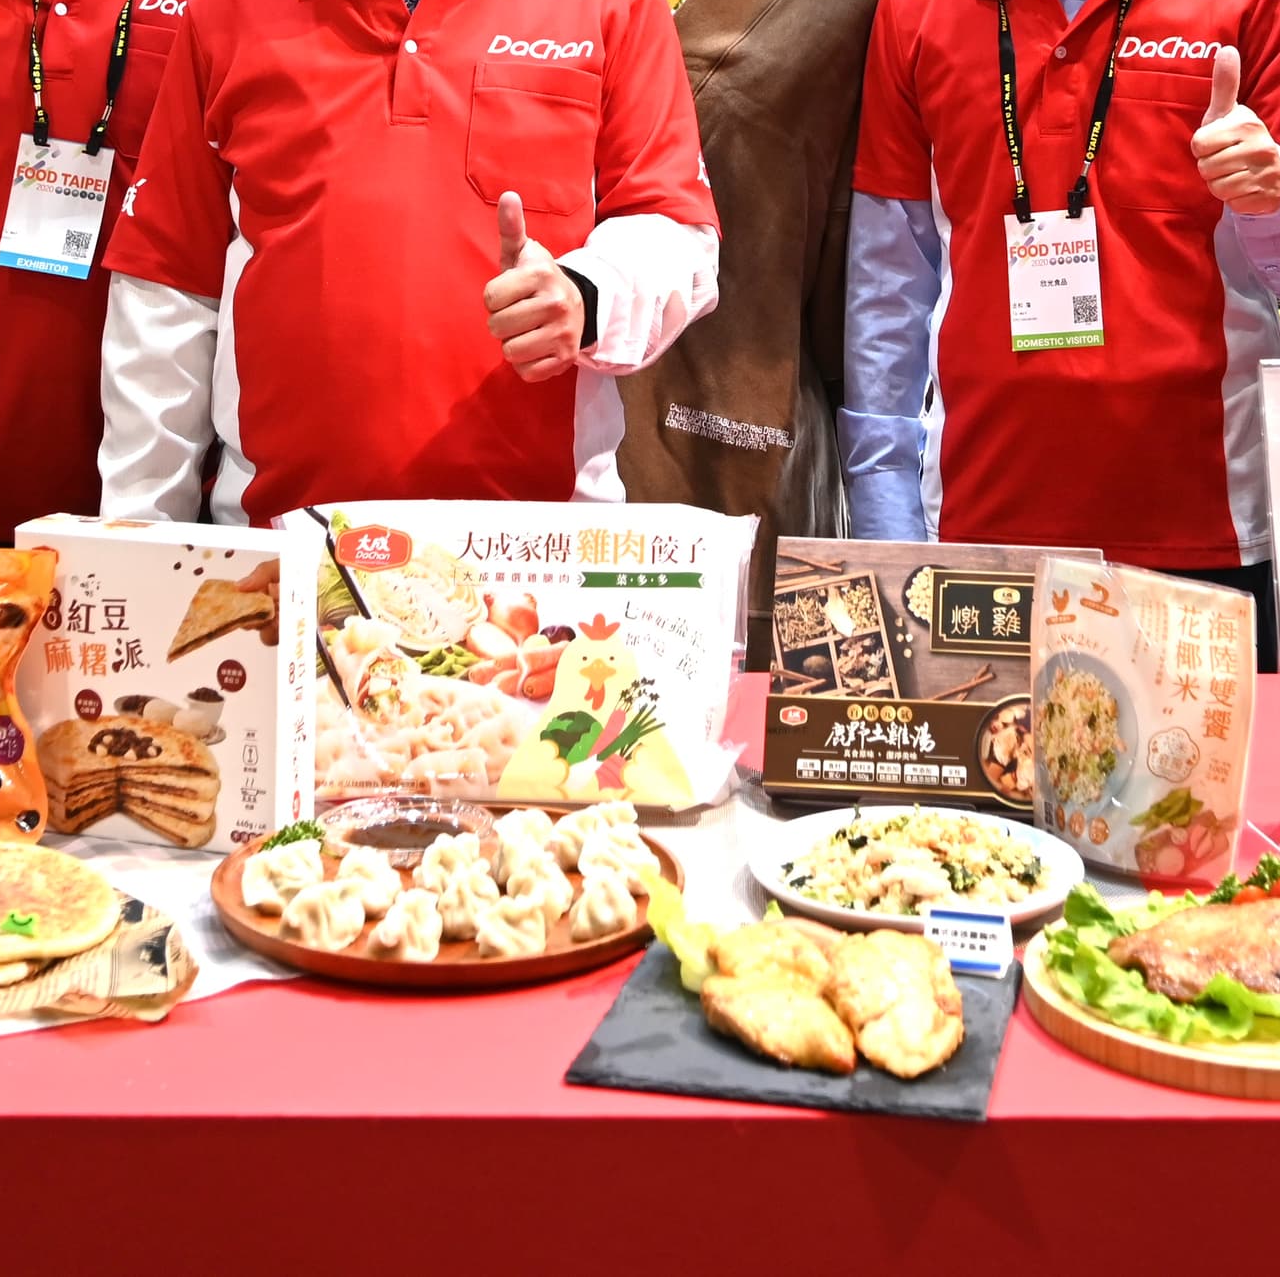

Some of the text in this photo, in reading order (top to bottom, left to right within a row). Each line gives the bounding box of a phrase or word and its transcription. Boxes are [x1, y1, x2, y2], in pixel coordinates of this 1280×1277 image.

[487, 34, 594, 60] DaChan
[1118, 36, 1222, 60] DaChan
[16, 165, 107, 193] FOOD TAIPEI
[35, 183, 54, 193] 2020
[1009, 239, 1096, 259] FOOD TAIPEI
[16, 257, 69, 274] EXHIBITOR
[1031, 258, 1049, 267] 2020
[1016, 335, 1100, 348] DOMESTIC VISITOR
[355, 534, 390, 551] 大成
[355, 550, 391, 562] DaChan
[67, 598, 131, 635] 紅豆
[950, 605, 1022, 638] 燉雞
[1170, 603, 1203, 703] 花椰米
[824, 721, 937, 753] 鹿野土雞湯
